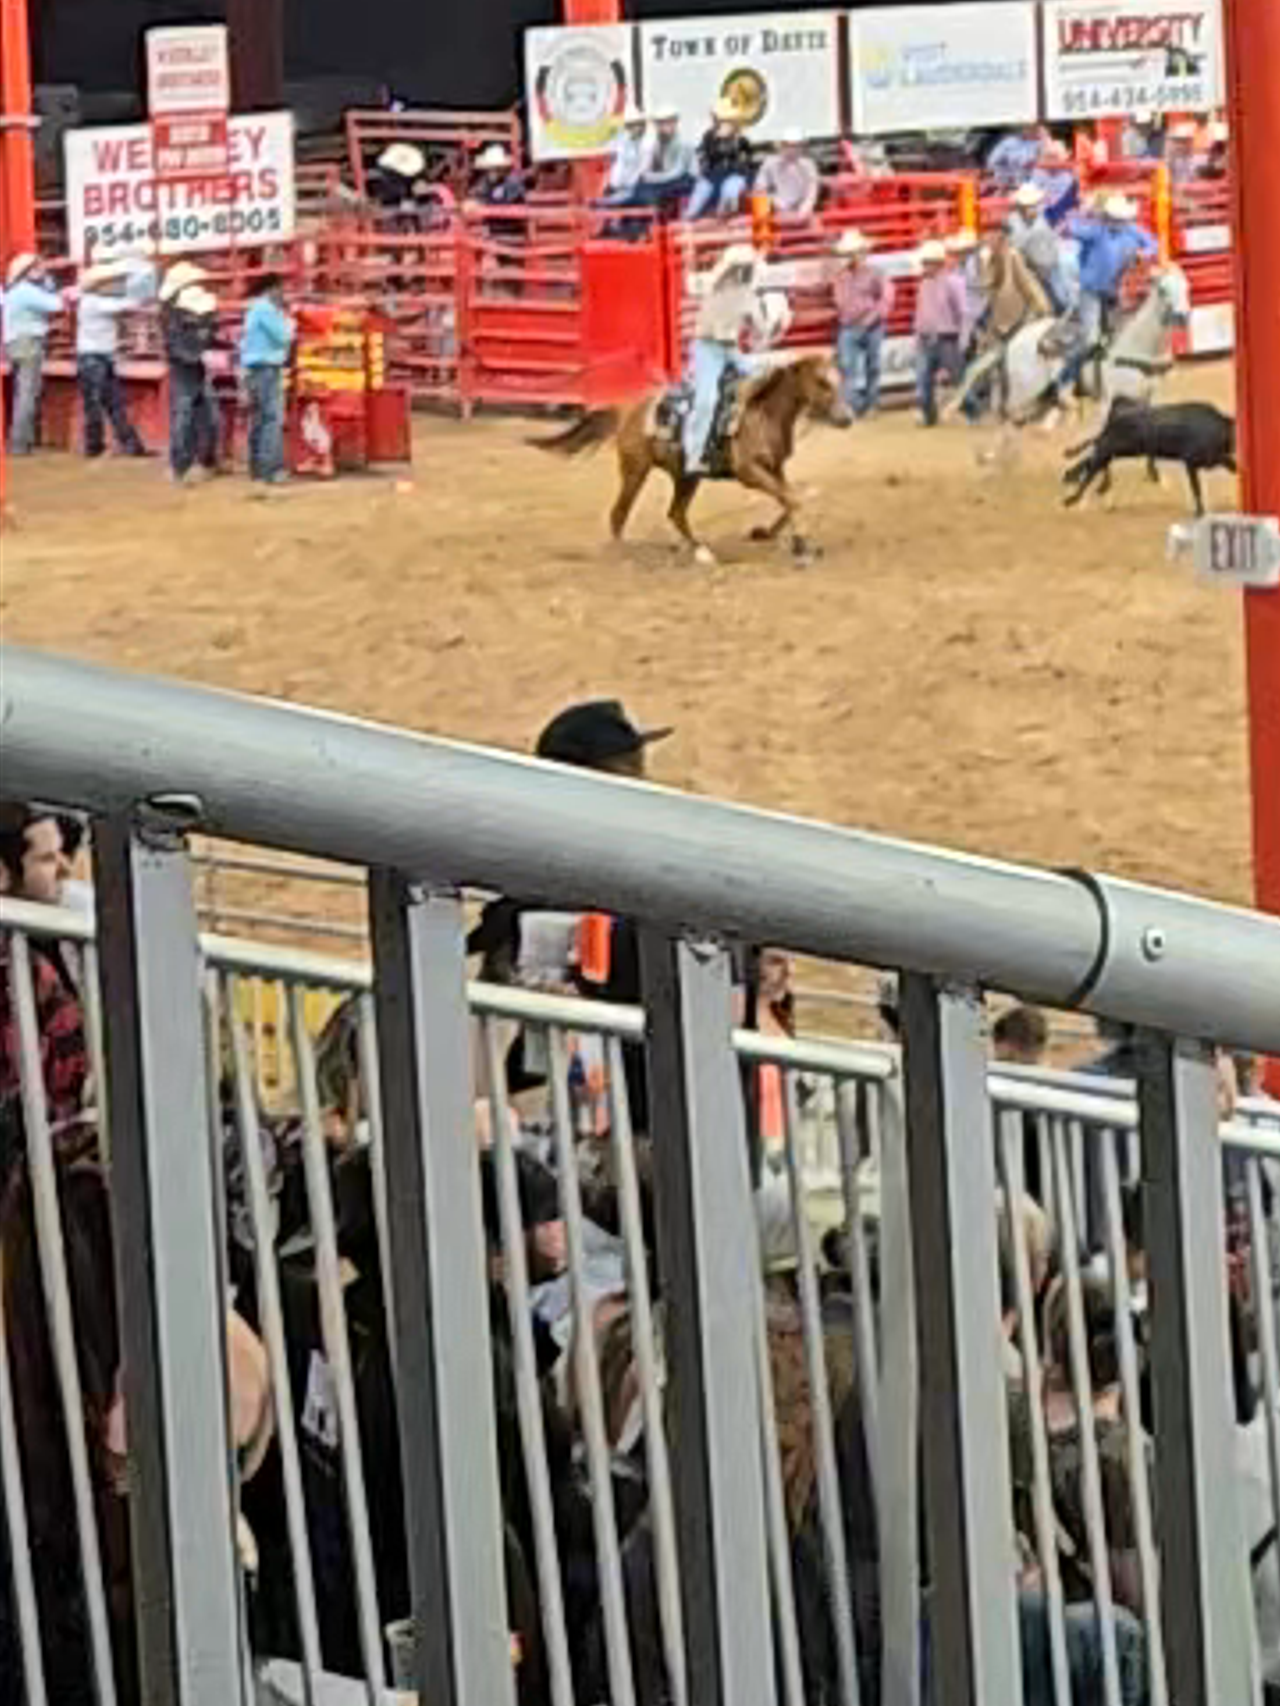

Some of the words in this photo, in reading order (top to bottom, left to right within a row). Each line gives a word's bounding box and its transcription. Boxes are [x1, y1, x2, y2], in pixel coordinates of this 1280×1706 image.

[1058, 13, 1204, 54] UNIVERSITY
[84, 169, 278, 219] BROTHERS
[1210, 523, 1256, 572] EXIT
